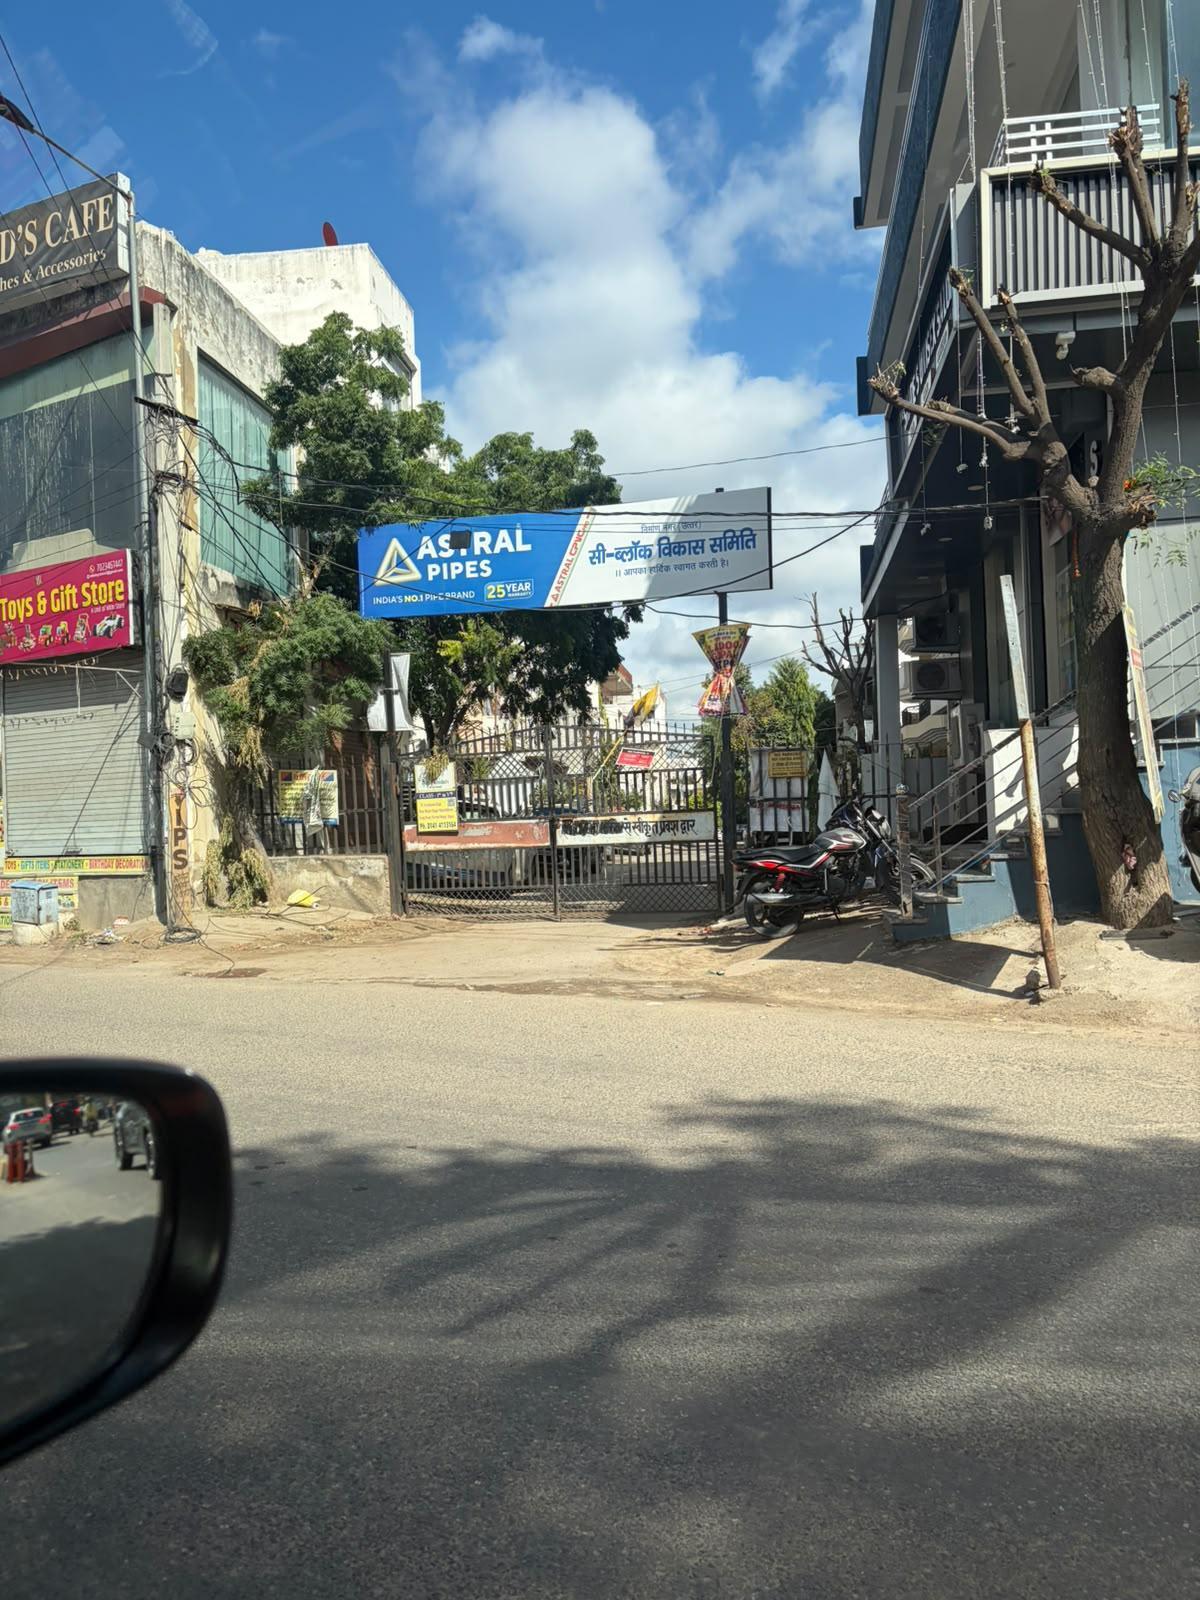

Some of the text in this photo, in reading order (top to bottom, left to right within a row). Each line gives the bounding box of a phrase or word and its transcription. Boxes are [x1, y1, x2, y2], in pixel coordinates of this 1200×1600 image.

[45, 193, 115, 248] CAFE
[22, 269, 33, 285] &
[35, 248, 107, 281] Accessories
[416, 528, 533, 560] ASRAL
[588, 527, 757, 566] सी-ब्लॉक विकास समिति
[427, 559, 493, 582] PIPES
[555, 557, 574, 592] ASTRAL
[0, 579, 125, 623] Toys & Gift Store
[372, 595, 403, 605] INDIA'S
[404, 594, 424, 603] NO.1
[486, 582, 532, 599] 25 YEAR
